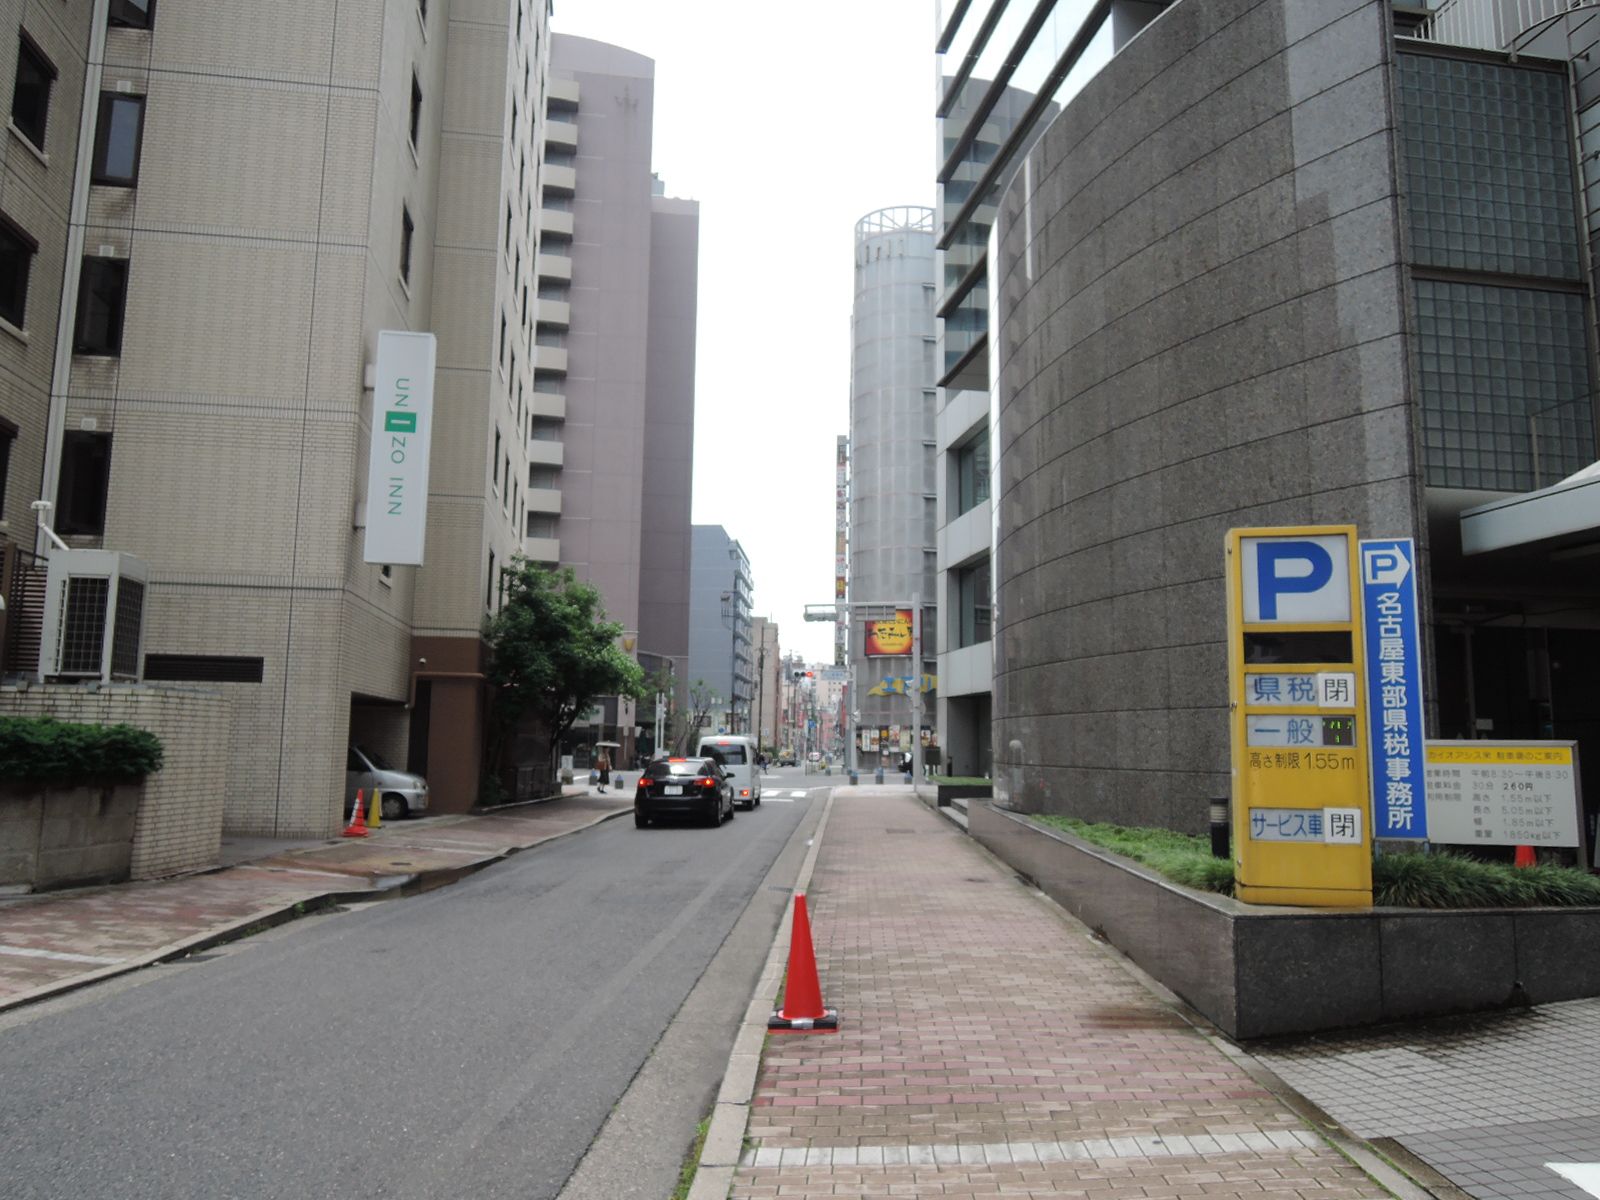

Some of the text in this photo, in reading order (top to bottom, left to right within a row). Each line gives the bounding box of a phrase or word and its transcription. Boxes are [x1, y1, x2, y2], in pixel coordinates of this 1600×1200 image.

[387, 378, 411, 515] UNIZO INN
[1256, 541, 1333, 620] P
[1370, 554, 1398, 580] P
[1254, 676, 1349, 703] 県税 閉
[1376, 592, 1414, 830] 名古屋東部県税事務所
[1254, 717, 1314, 744] 一般
[1249, 752, 1301, 769] 高さ制限
[1503, 782, 1534, 791] 260円
[1252, 813, 1355, 838] サービス車 閉
